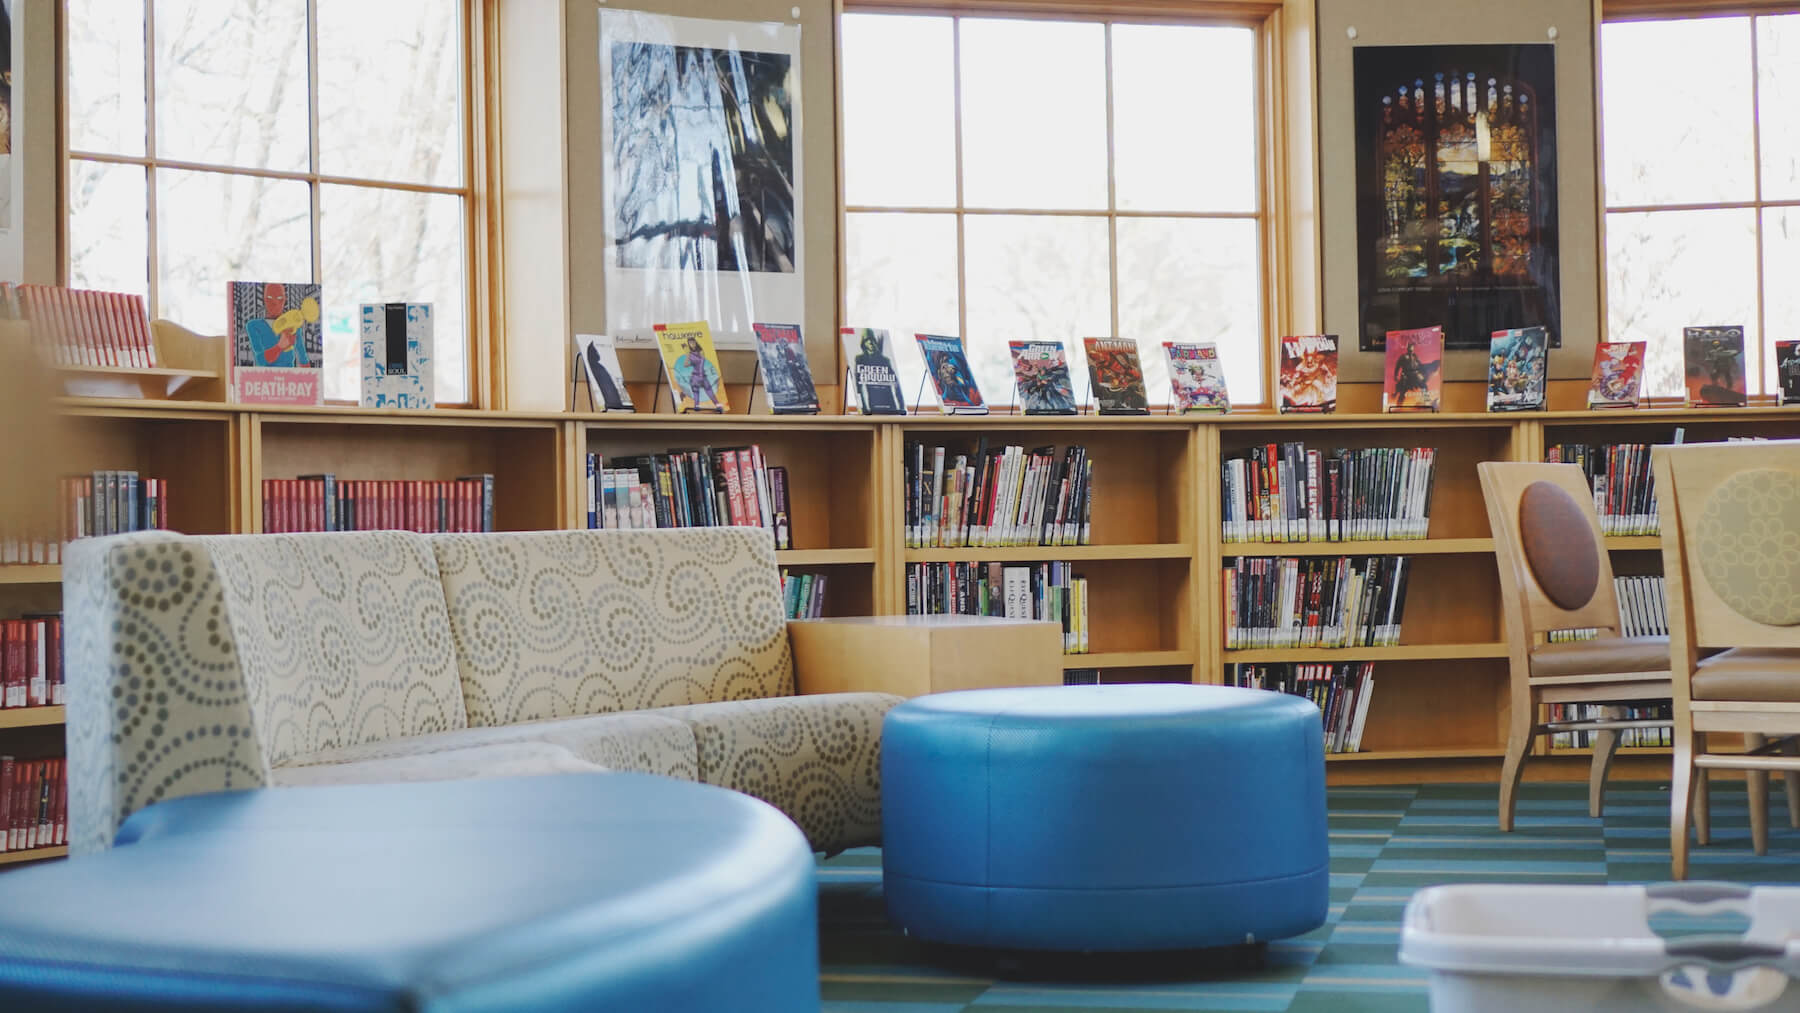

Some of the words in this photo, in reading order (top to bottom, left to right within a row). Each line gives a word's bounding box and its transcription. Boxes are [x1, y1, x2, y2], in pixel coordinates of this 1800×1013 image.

[1687, 327, 1741, 337] HALO
[857, 364, 889, 374] GREEN
[860, 373, 896, 383] ARROW
[245, 381, 313, 397] DEATH-RAY
